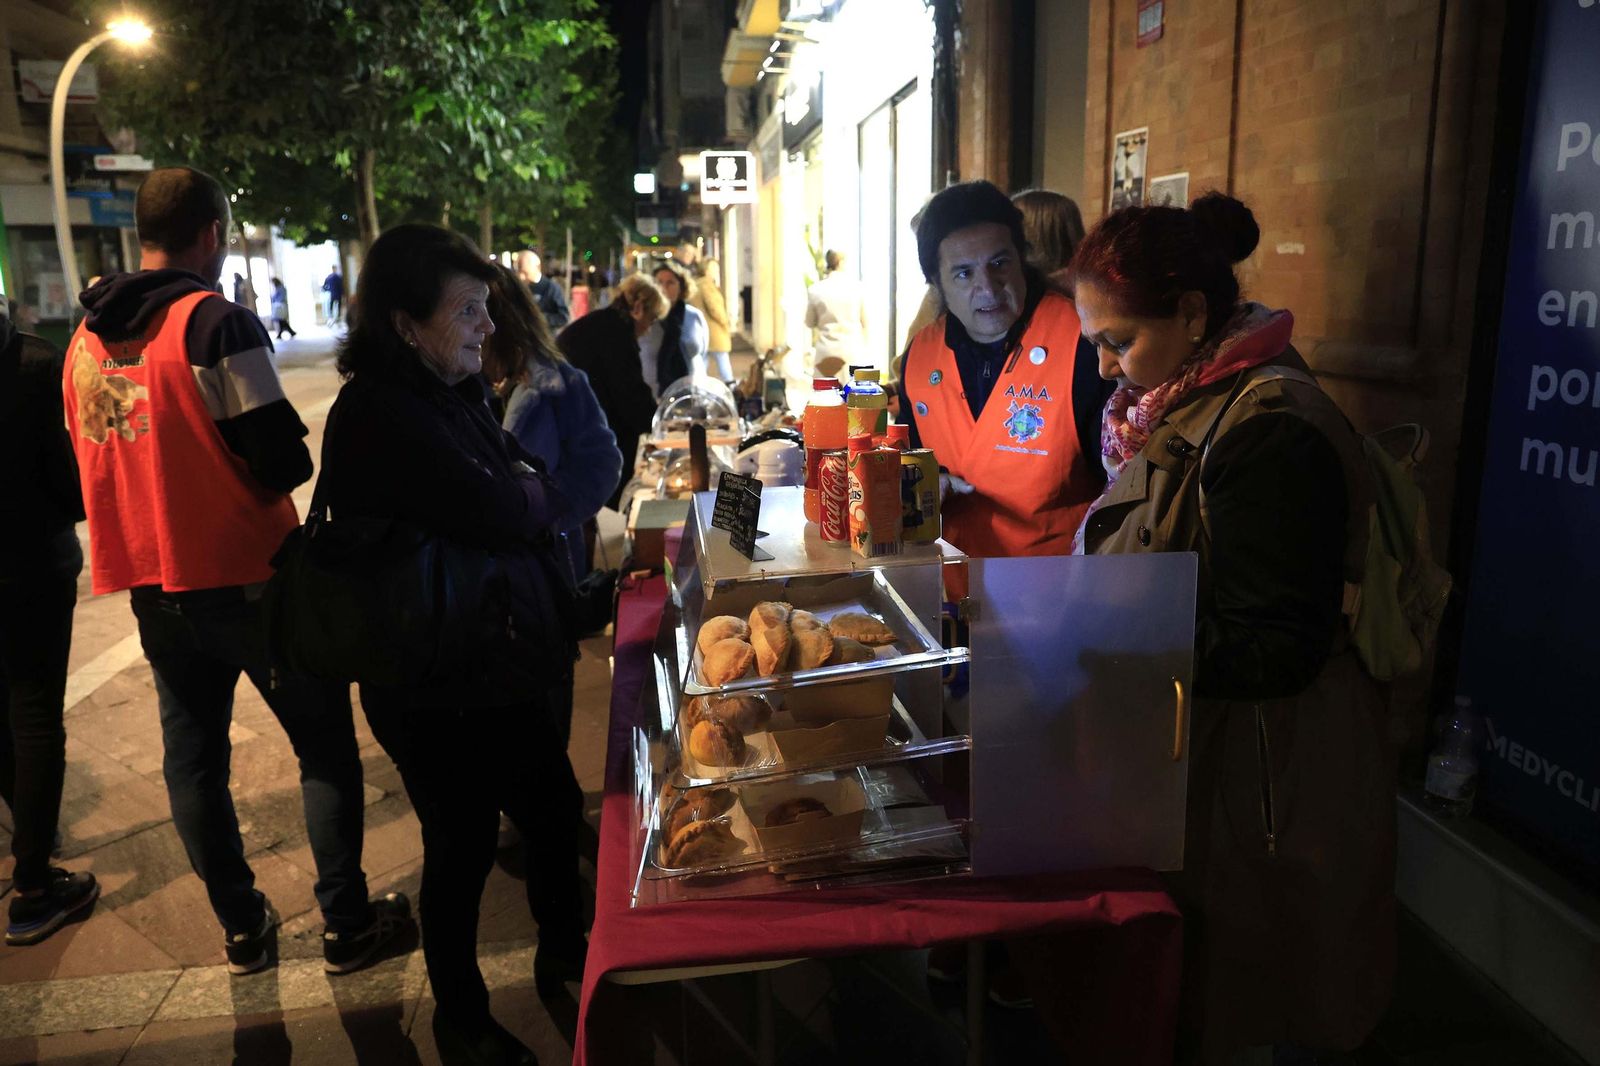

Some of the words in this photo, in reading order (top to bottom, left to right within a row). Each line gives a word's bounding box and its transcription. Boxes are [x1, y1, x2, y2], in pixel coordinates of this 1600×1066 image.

[1556, 121, 1600, 172] P
[1547, 210, 1600, 250] m
[1538, 288, 1599, 328] en
[1004, 384, 1052, 401] A.M.A.
[1520, 436, 1599, 487] mu
